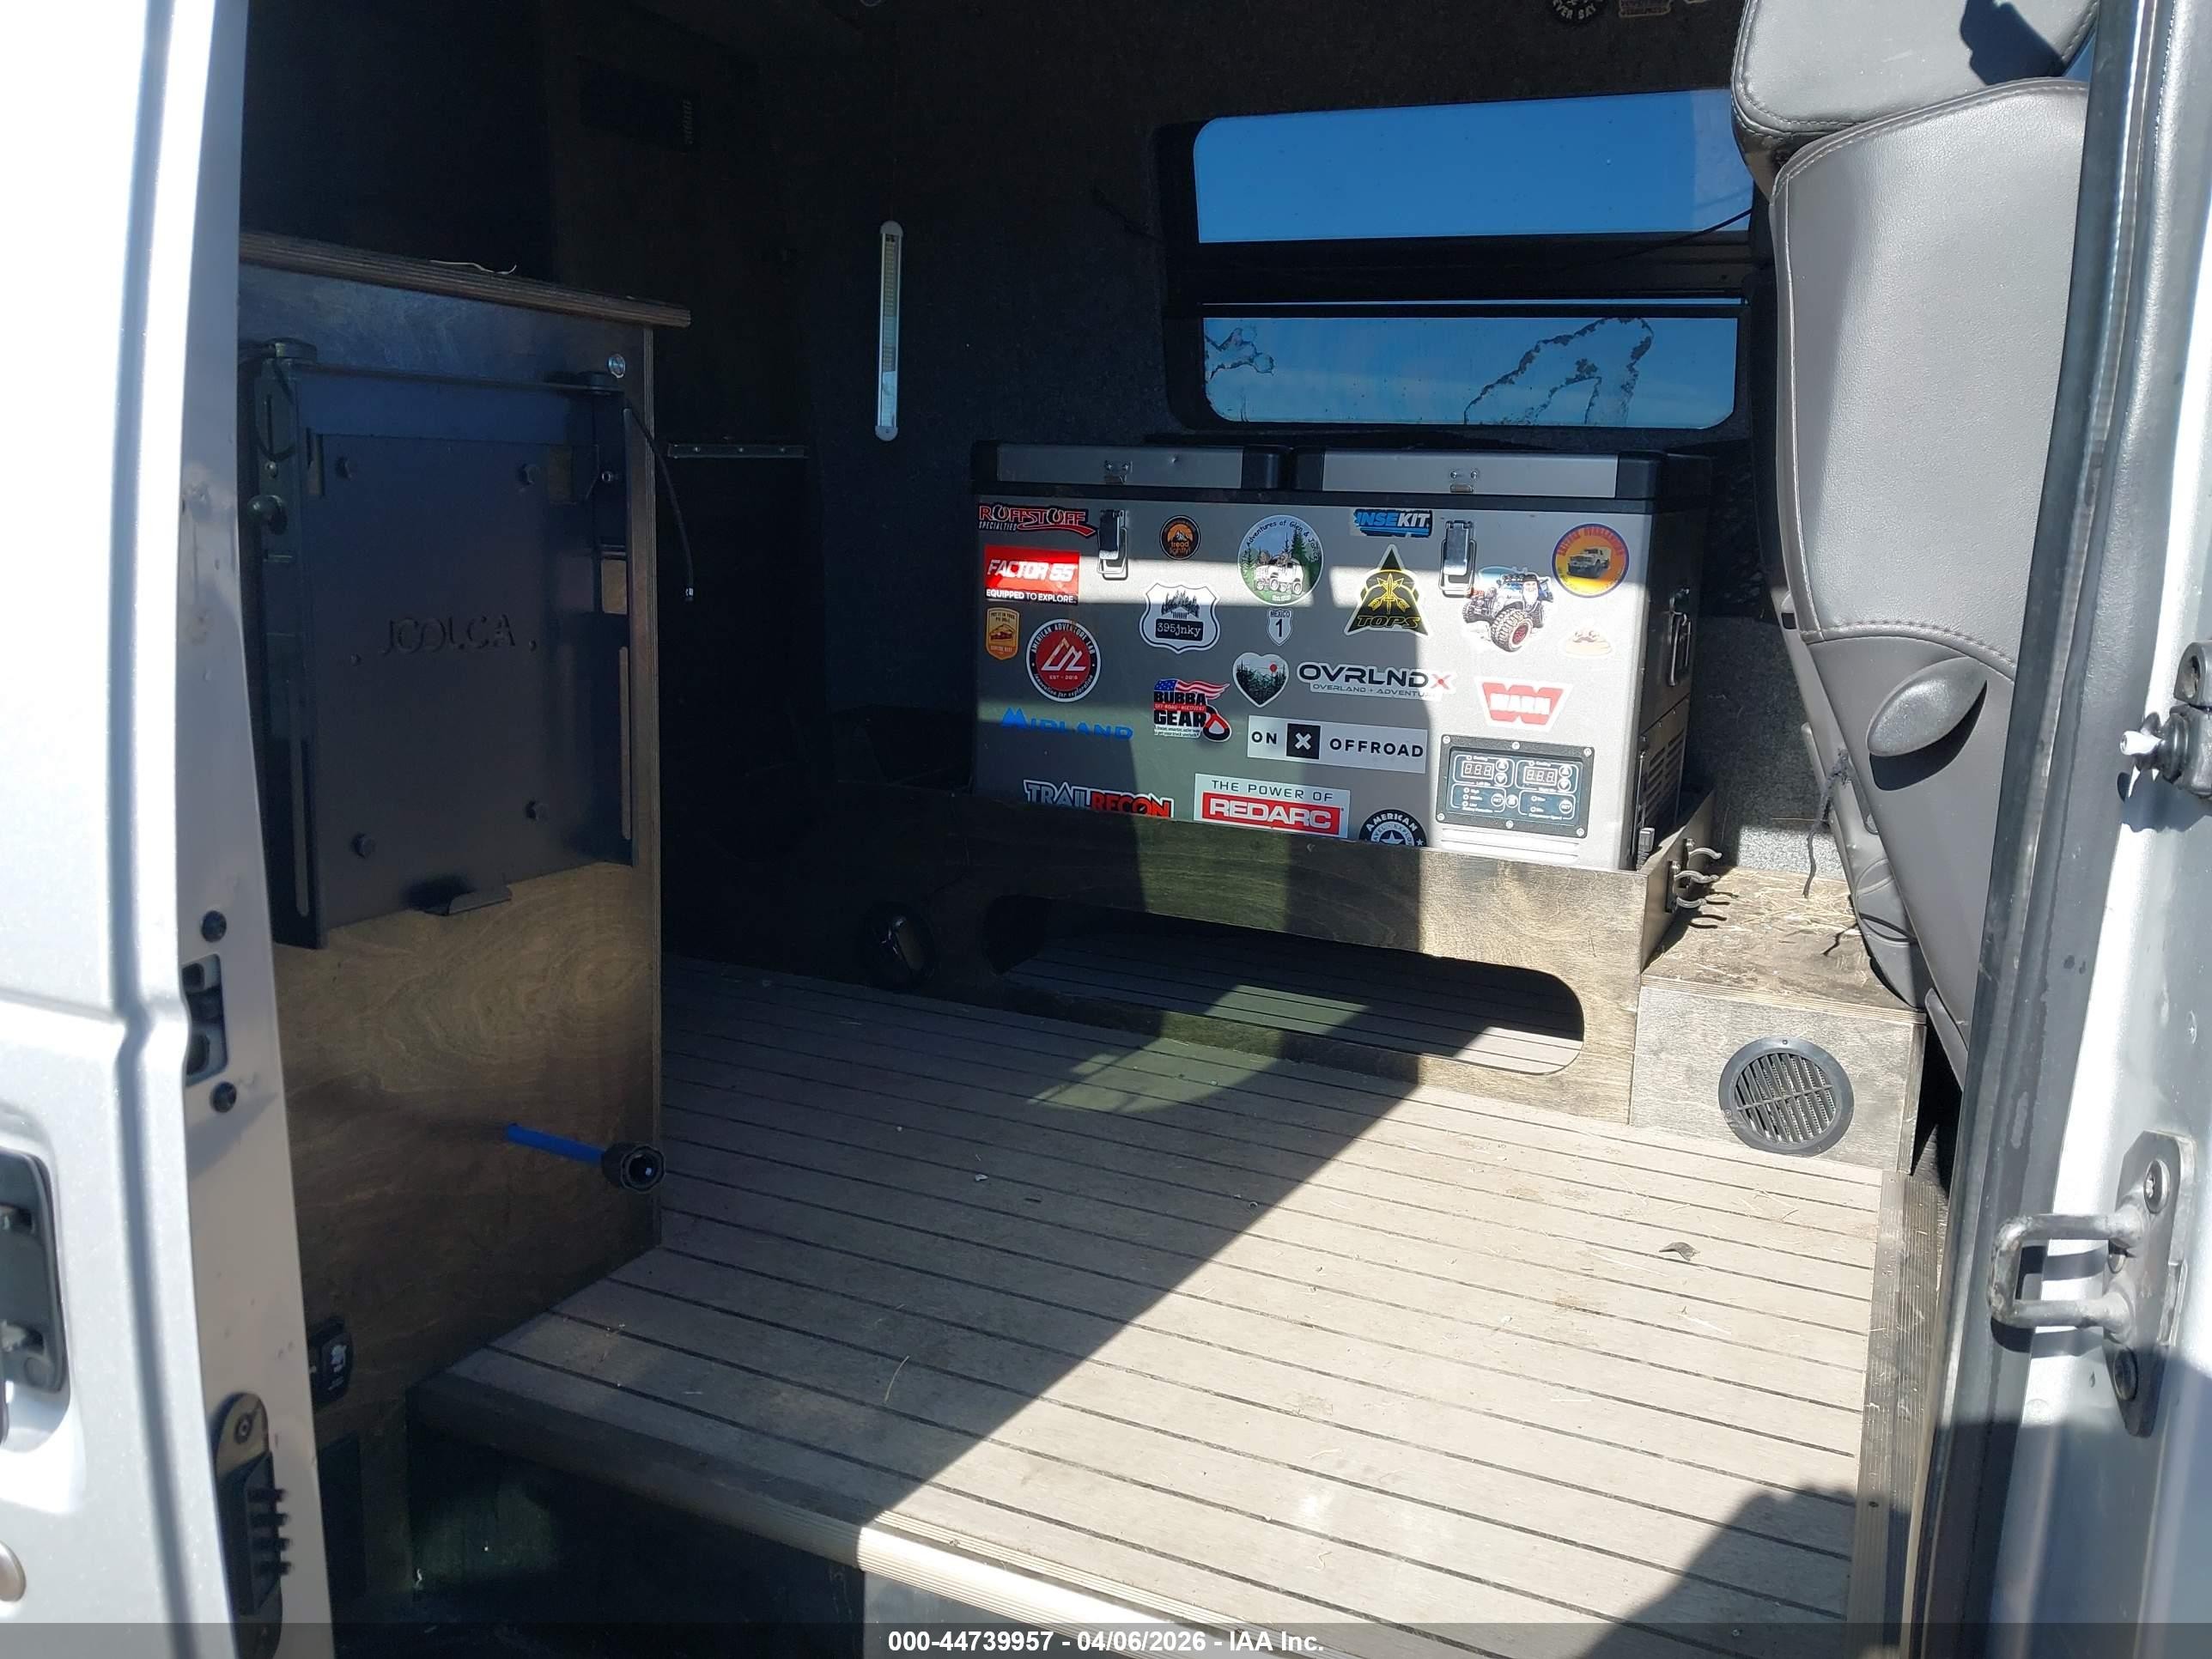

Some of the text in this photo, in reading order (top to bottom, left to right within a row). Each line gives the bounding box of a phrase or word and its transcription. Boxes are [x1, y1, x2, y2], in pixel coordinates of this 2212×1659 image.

[979, 520, 1018, 531] SPECIALTIES
[1357, 512, 1431, 527] INSEKIT
[1247, 521, 1277, 547] Adventures
[1289, 521, 1304, 532] Glen
[988, 559, 1076, 582] FACTOR 55
[986, 589, 1025, 600] EQUIPPED
[1026, 592, 1037, 600] TO
[1157, 622, 1201, 638] 395jnky
[1275, 618, 1282, 637] 1
[1357, 615, 1421, 628] TOPS
[1031, 623, 1096, 654] AMERICAN ADVENTURE LAB
[1154, 691, 1206, 706] BUBBA
[1312, 684, 1366, 693] OVERLAND
[1376, 688, 1434, 698] ADVENTU
[1154, 710, 1206, 727] GEAR
[1251, 732, 1278, 744] ON
[1329, 738, 1424, 757] OFFROAD
[1212, 780, 1334, 802] THE POWER OF
[1209, 798, 1332, 829] REDARC
[1366, 812, 1419, 832] AMERICAN
